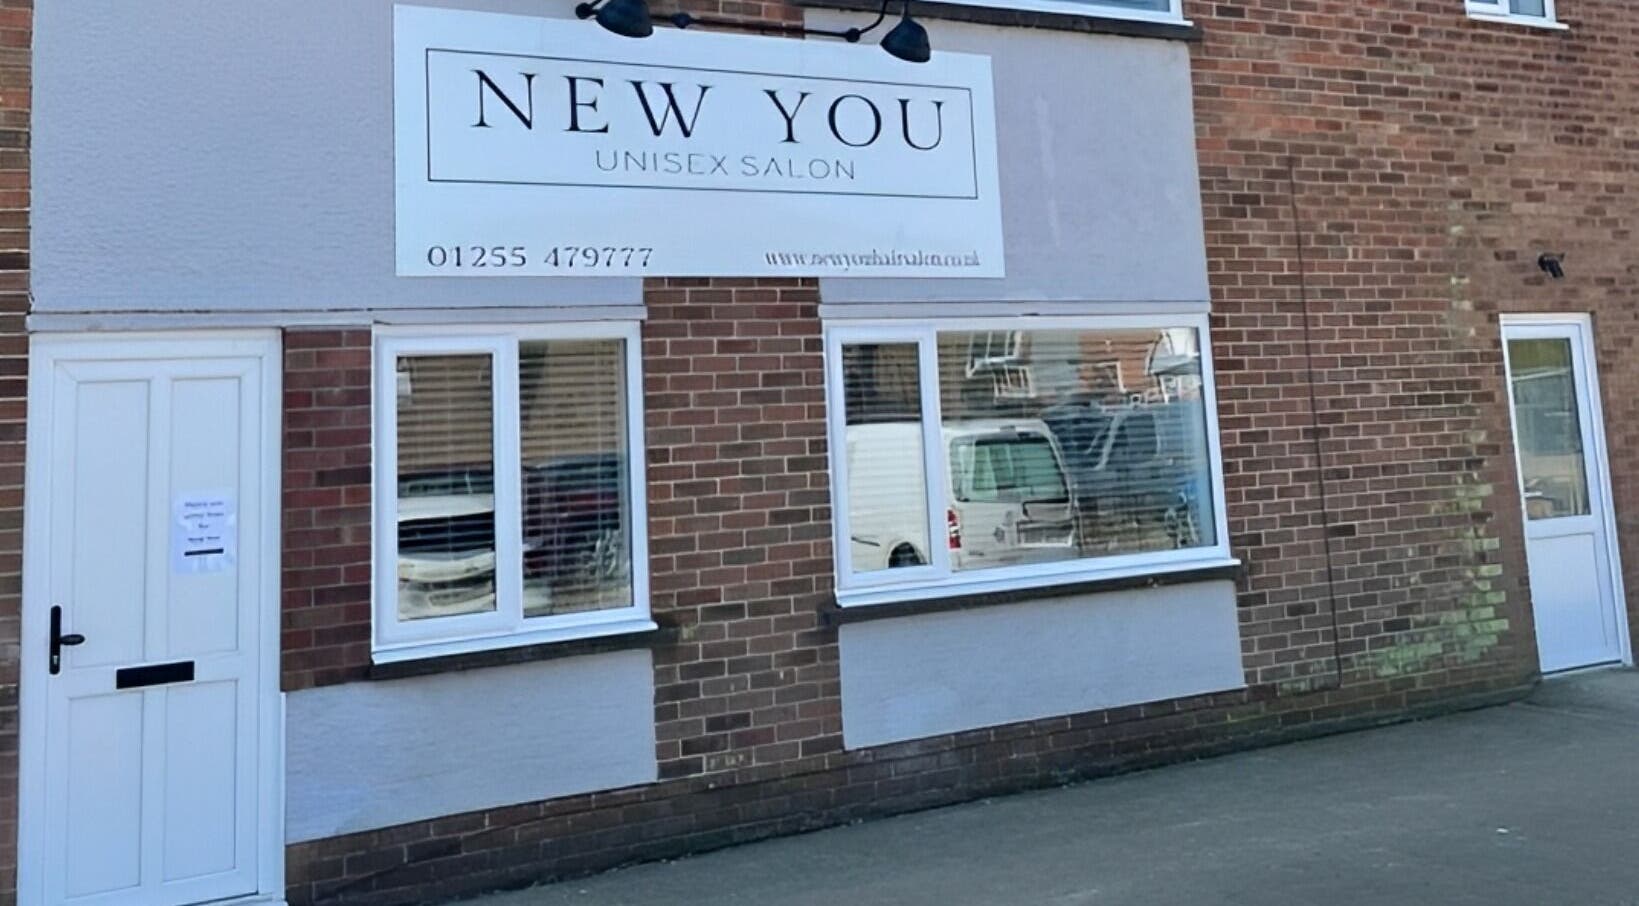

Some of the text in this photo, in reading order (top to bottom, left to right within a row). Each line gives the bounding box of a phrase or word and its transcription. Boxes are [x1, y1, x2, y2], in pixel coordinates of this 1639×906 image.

[470, 69, 944, 151] NEW YOU
[595, 149, 856, 181] UNISEX SALON
[426, 245, 654, 269] 01255 479777
[765, 249, 981, 271] wwwnwyohaisalonco
